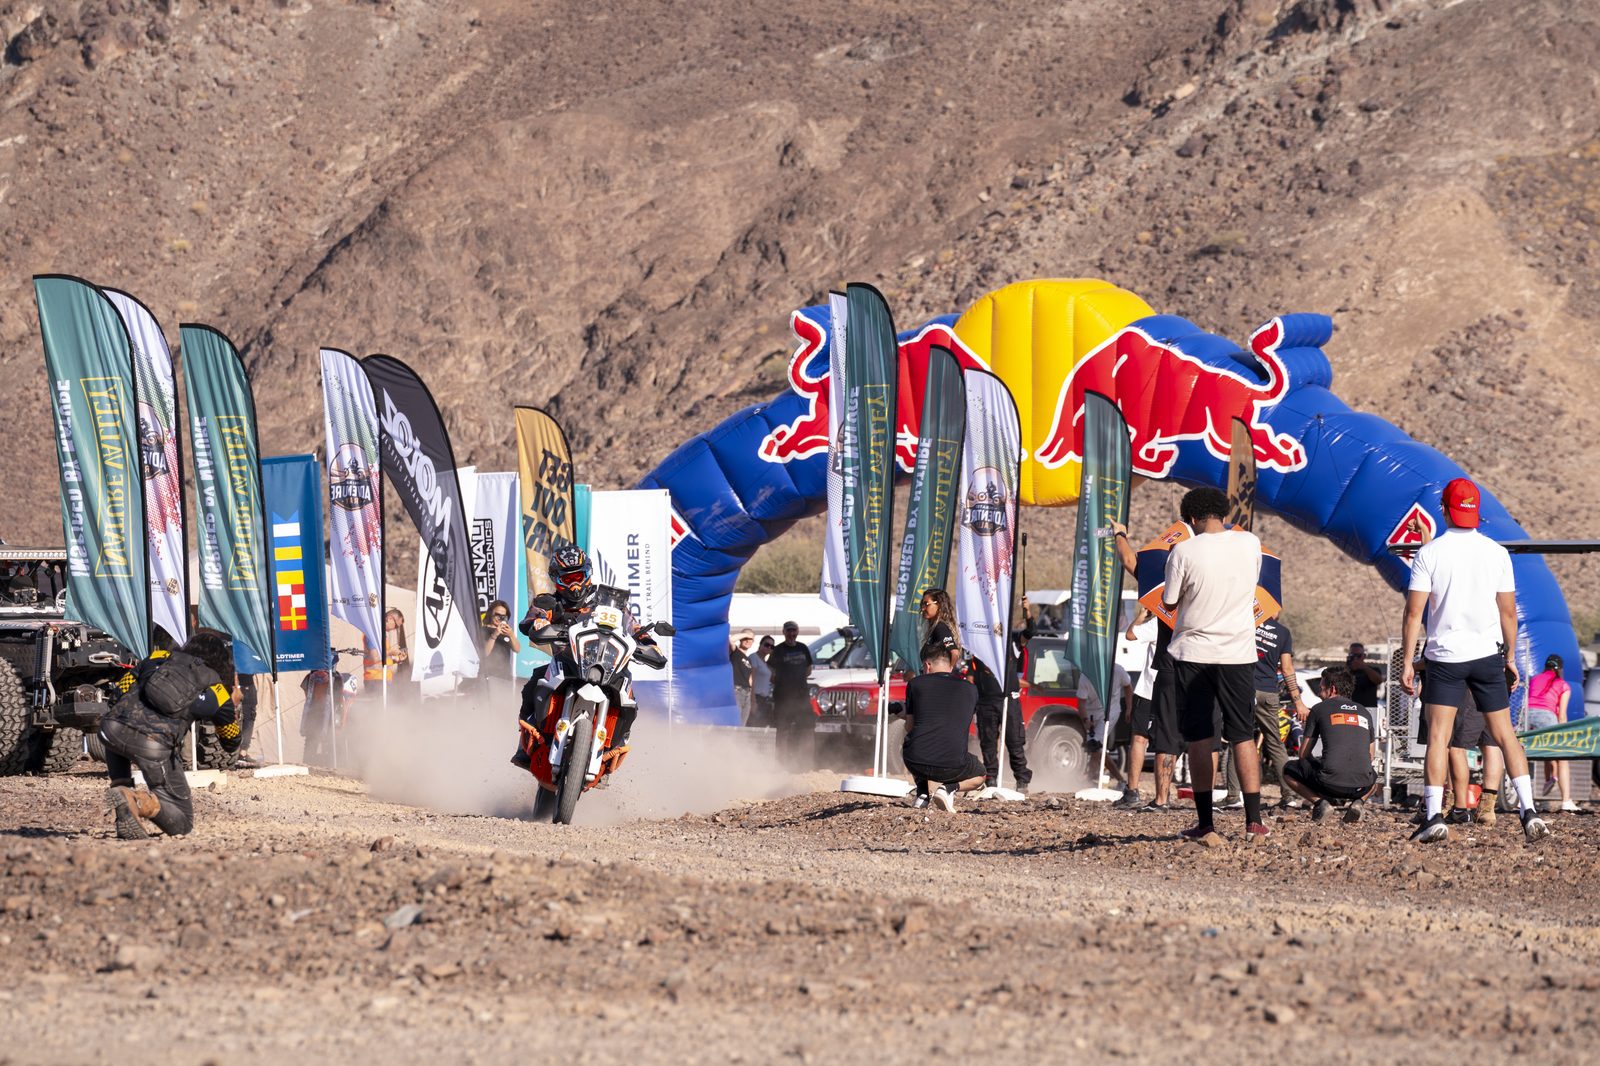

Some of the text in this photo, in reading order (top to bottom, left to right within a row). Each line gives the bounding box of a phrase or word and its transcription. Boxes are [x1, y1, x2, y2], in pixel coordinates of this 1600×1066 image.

[471, 518, 490, 612] DENALI
[485, 519, 497, 604] LECTRONICS
[627, 532, 642, 626] DTIMER
[599, 611, 618, 623] 35
